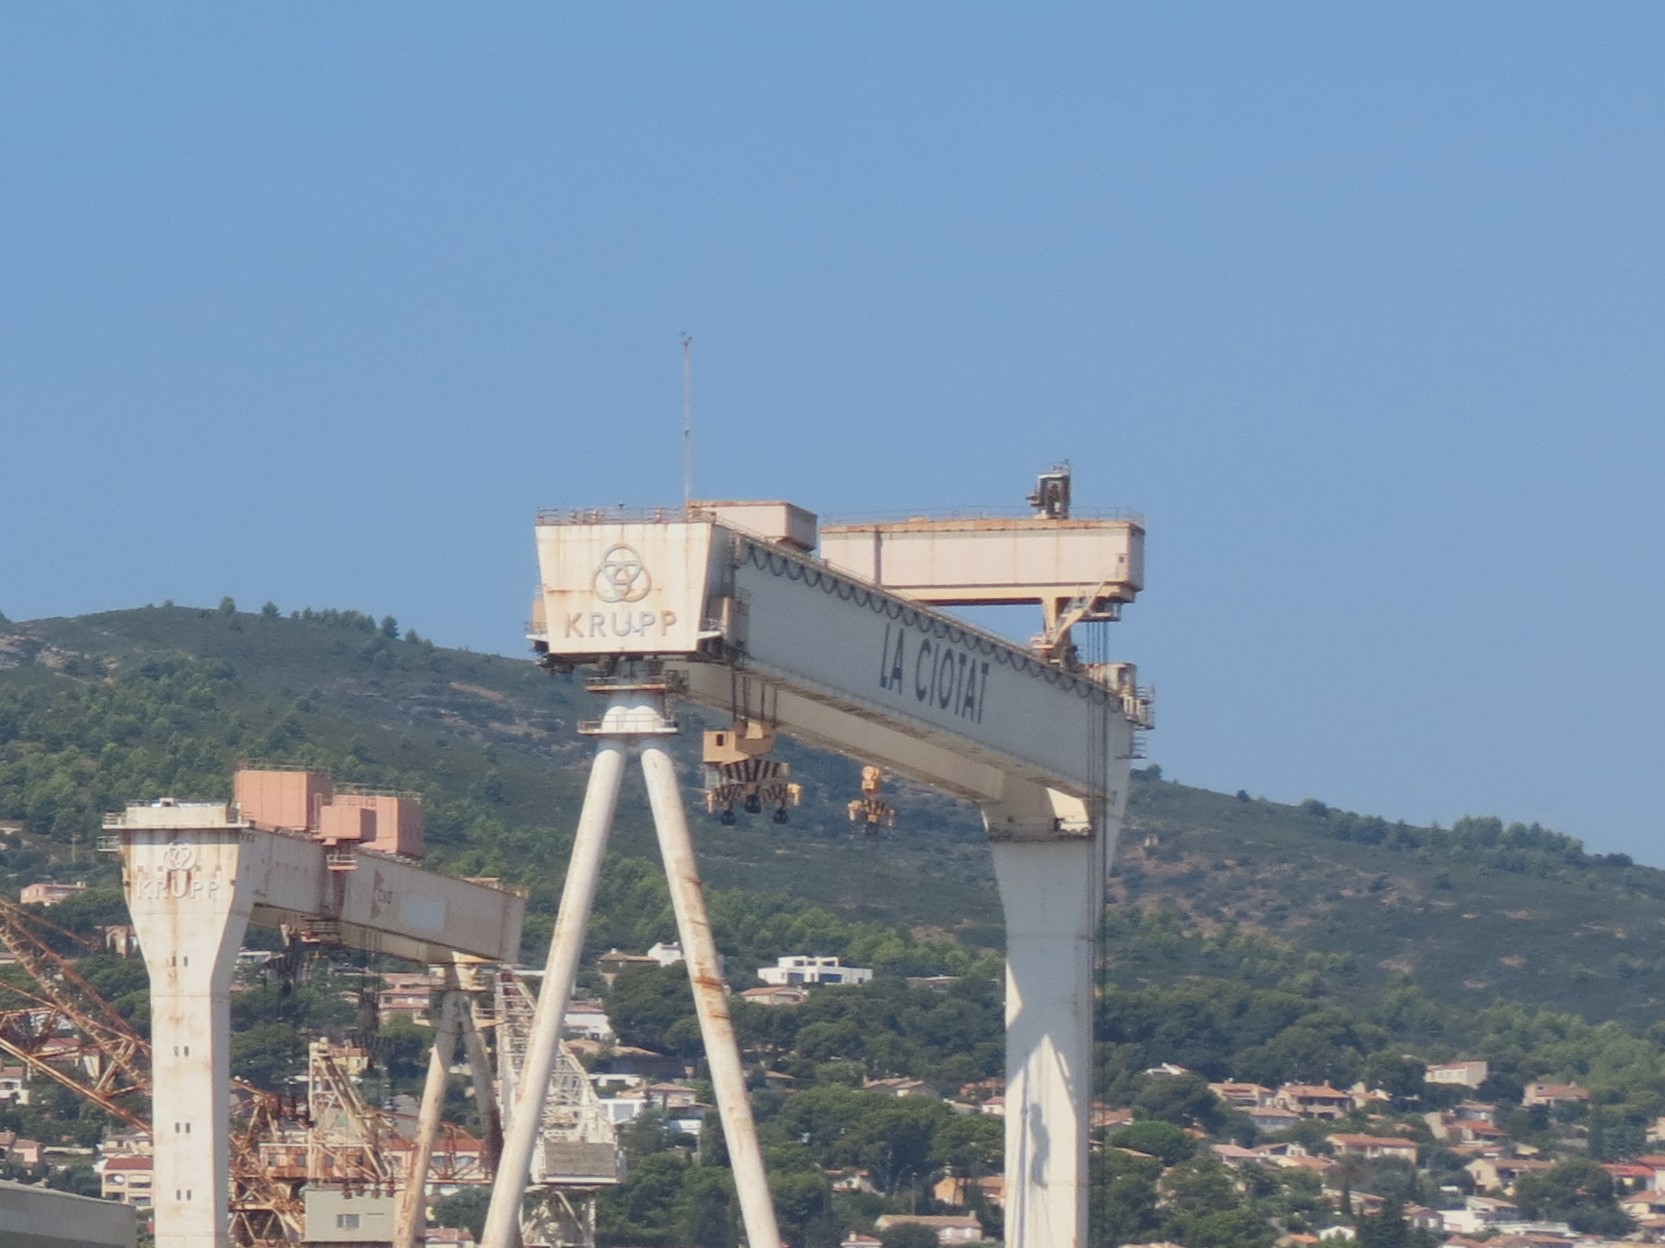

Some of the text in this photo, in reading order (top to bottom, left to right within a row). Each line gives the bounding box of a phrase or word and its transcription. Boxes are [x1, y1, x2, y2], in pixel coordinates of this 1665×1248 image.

[564, 611, 677, 638] KRUPP
[880, 623, 989, 724] LA CIOTAT
[137, 881, 220, 899] KRUPP
